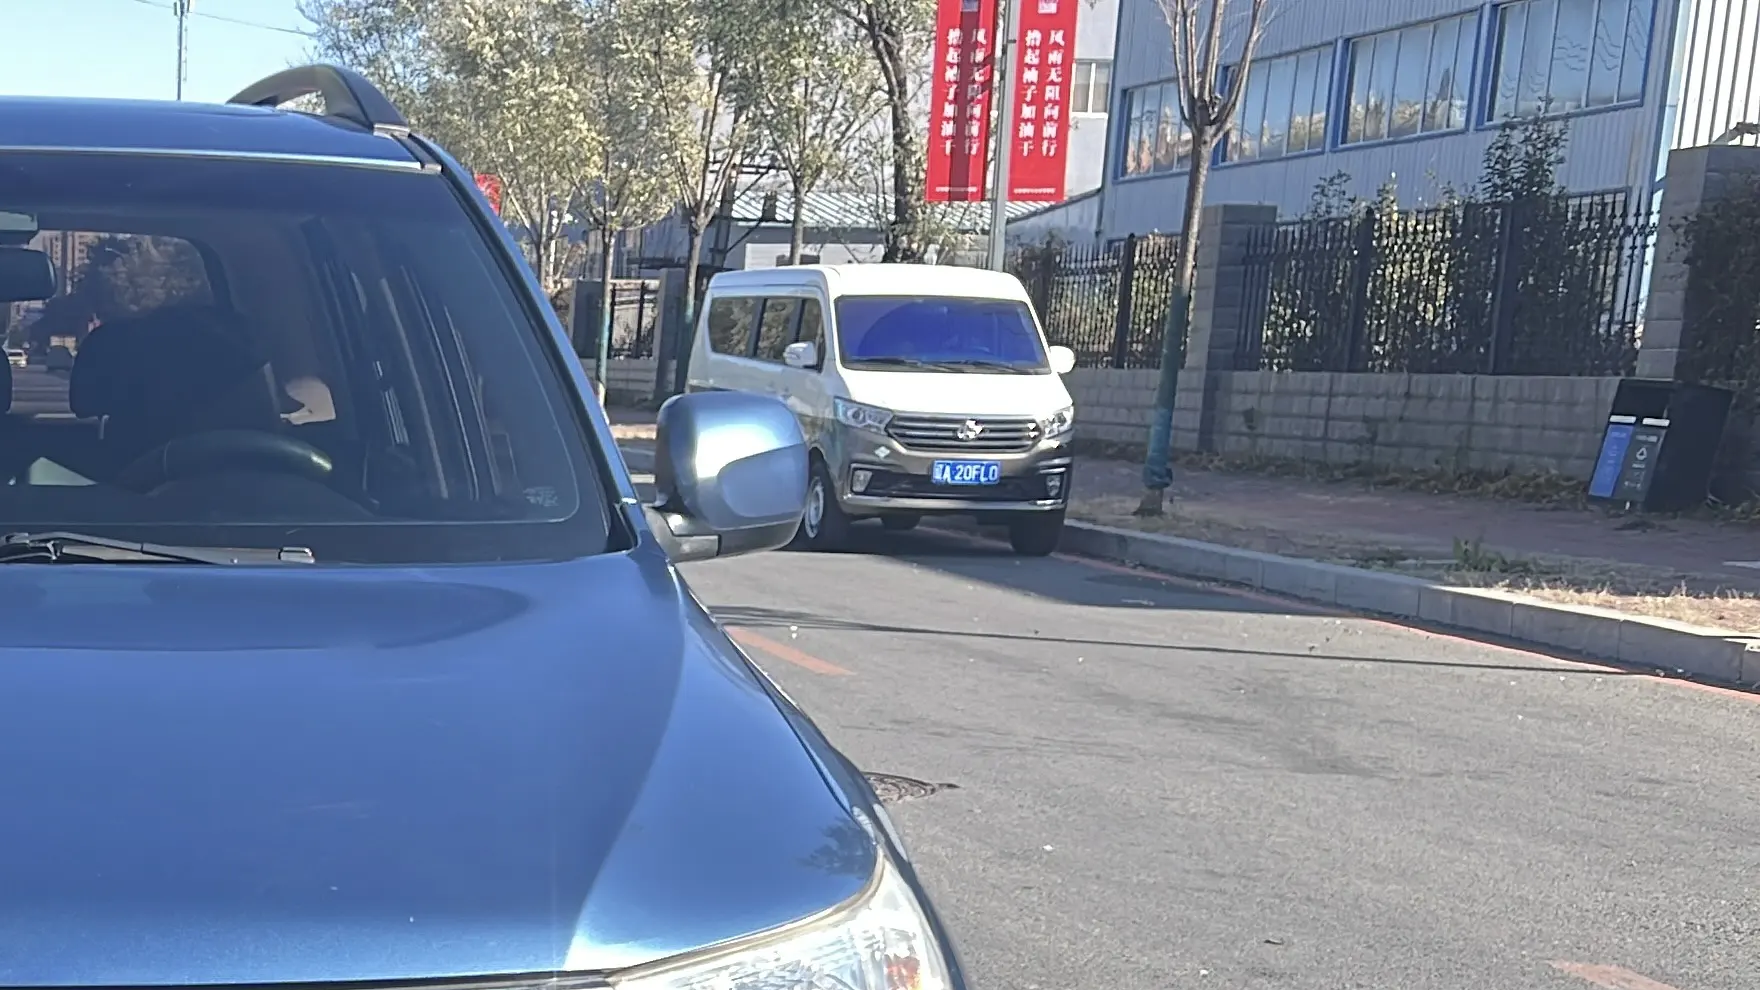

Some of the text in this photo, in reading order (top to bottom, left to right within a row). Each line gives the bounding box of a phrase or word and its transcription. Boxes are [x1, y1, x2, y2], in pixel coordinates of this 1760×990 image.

[1042, 29, 1065, 157] 风雨无阻向前行
